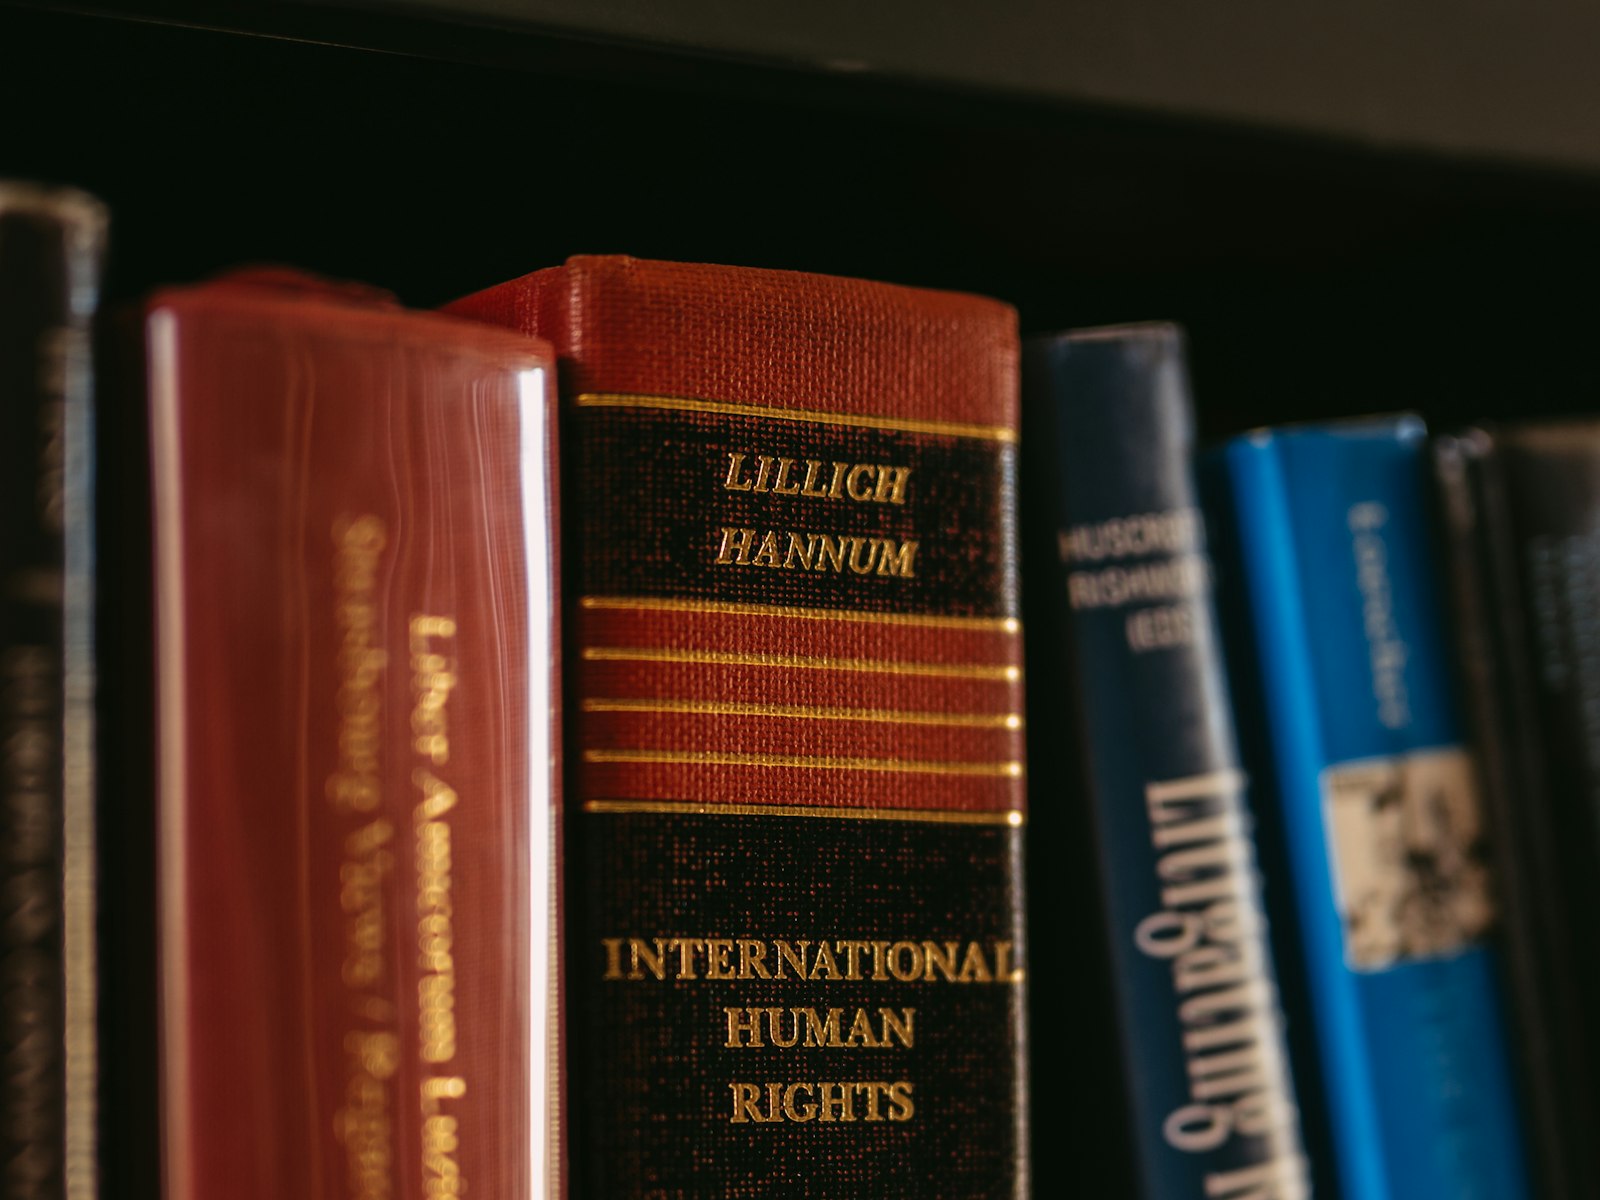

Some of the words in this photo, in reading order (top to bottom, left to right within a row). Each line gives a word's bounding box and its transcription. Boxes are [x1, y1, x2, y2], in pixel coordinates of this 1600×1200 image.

[723, 452, 913, 505] LILLICH
[716, 526, 919, 579] HANNUM
[602, 938, 1025, 983] INTERNATIONAL
[723, 1007, 916, 1050] HUMAN
[729, 1081, 915, 1124] RIGHTS
